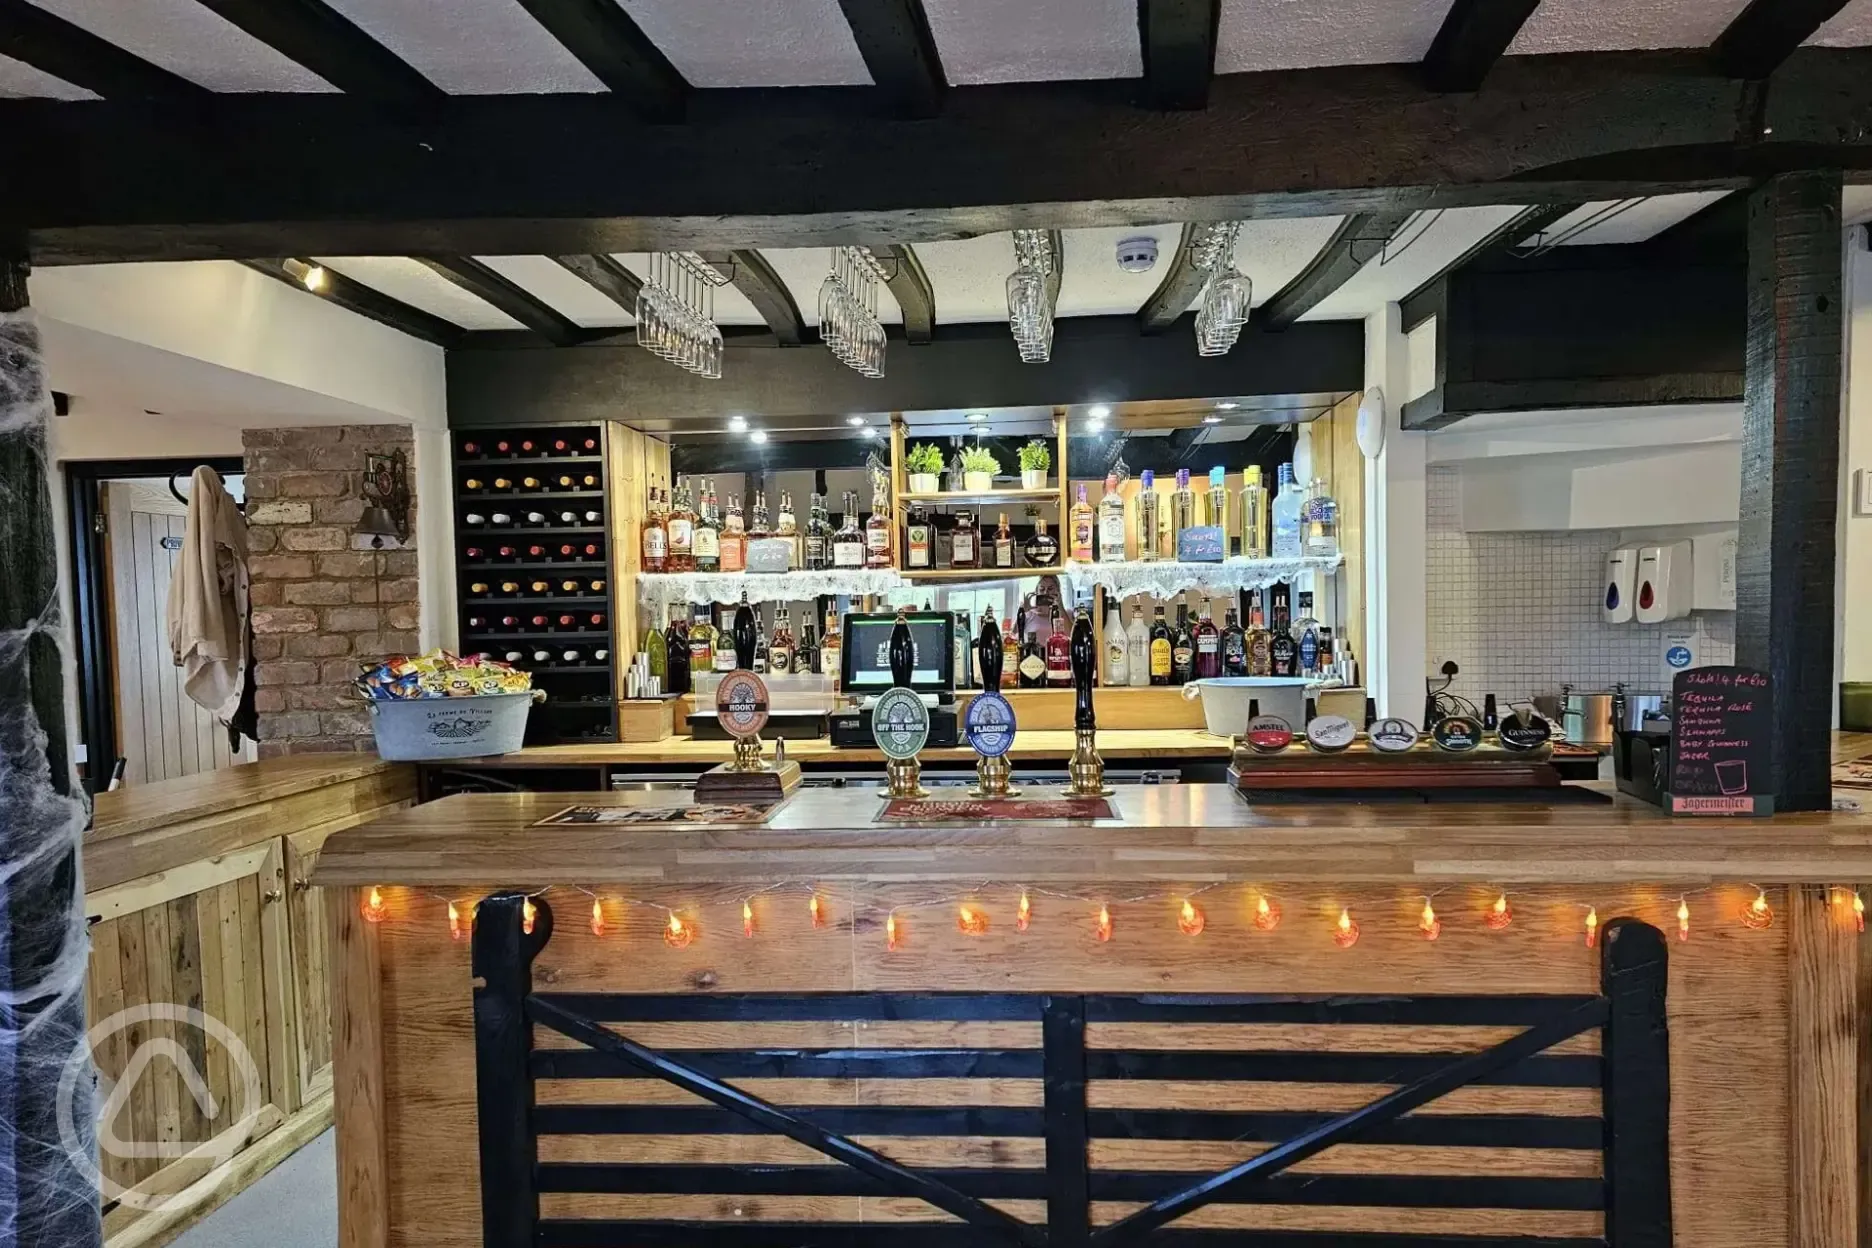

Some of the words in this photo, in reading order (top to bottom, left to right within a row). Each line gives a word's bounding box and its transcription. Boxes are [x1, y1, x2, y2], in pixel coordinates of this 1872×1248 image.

[1735, 674, 1746, 687] for
[1750, 673, 1767, 686] £10
[1680, 691, 1724, 703] TEQUILA
[1252, 723, 1285, 731] AMSTEL
